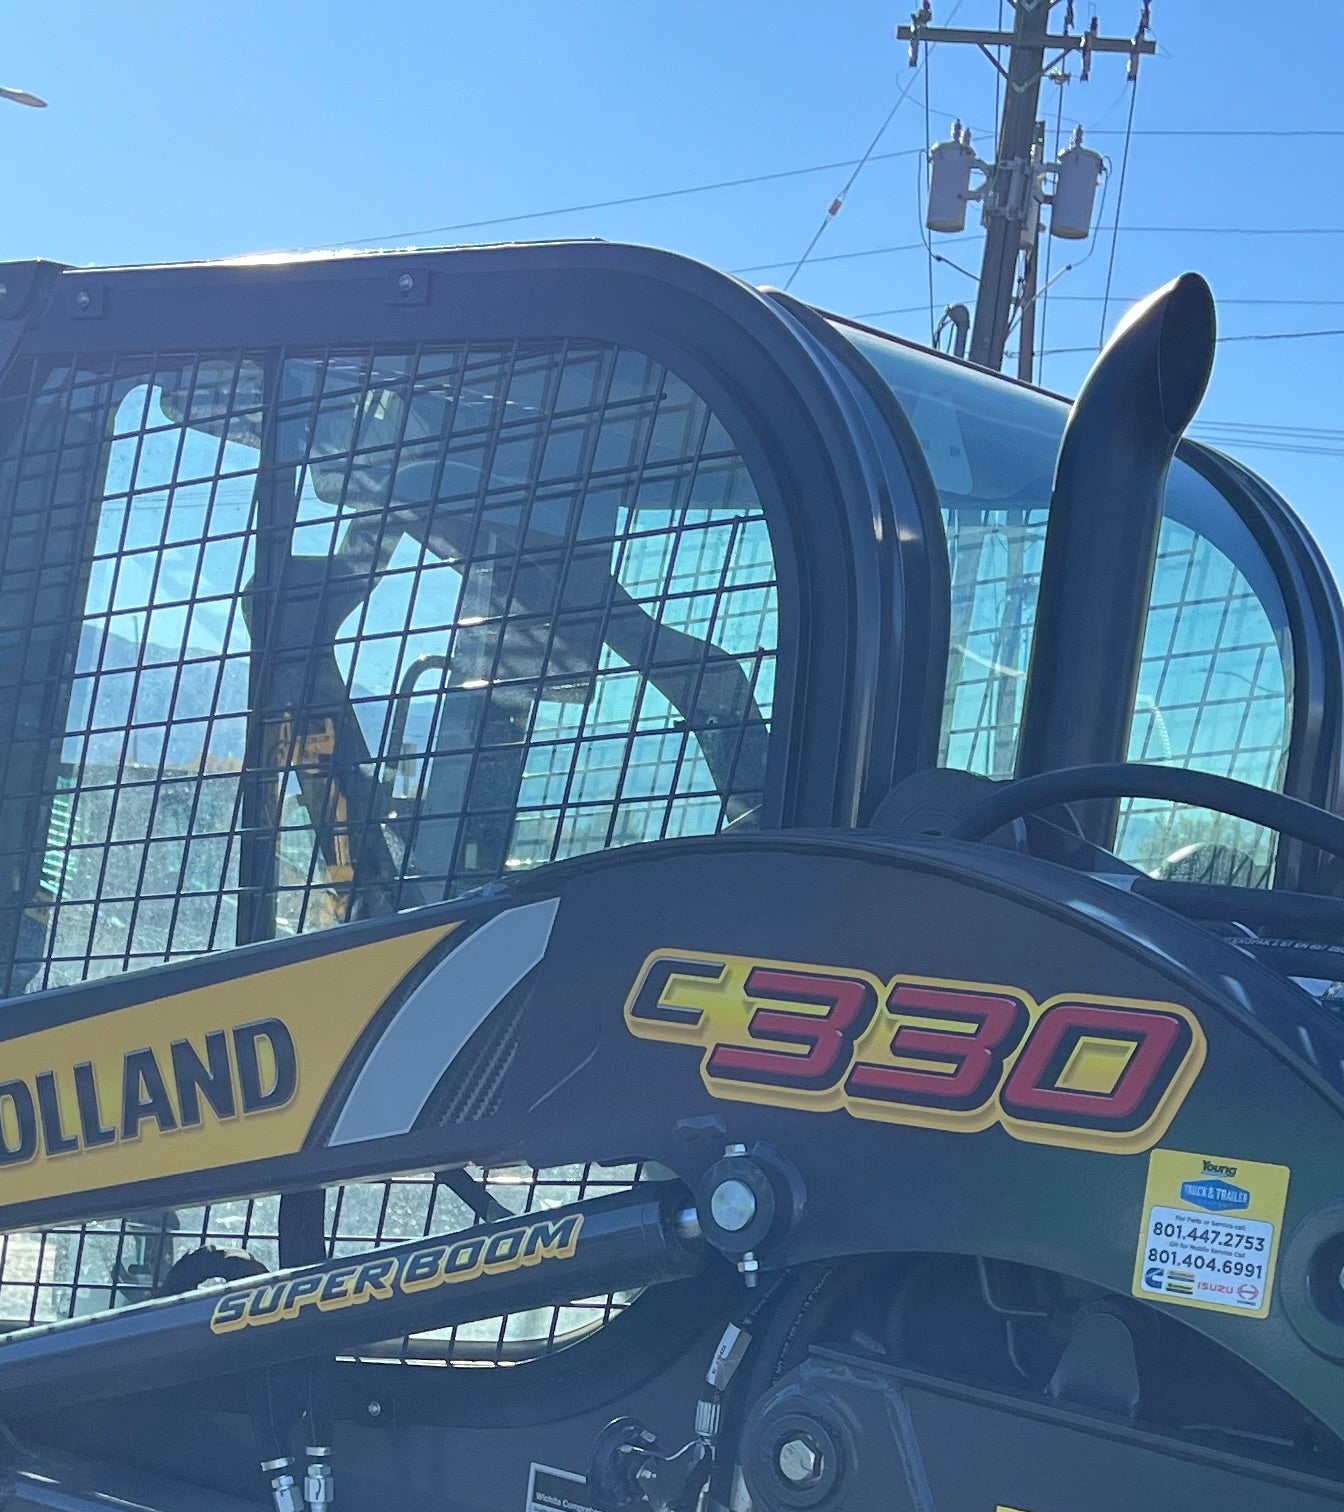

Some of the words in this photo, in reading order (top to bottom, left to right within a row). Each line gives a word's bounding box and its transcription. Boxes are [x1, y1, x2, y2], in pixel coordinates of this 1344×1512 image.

[626, 950, 1206, 1150] C330
[1201, 1159, 1237, 1178] Young
[1184, 1184, 1208, 1199] TRUCK
[1216, 1187, 1249, 1204] TRAILER
[1152, 1221, 1266, 1252] 801.447.2753
[211, 1257, 399, 1334] SUPER
[401, 1214, 585, 1293] BOOM
[1147, 1247, 1263, 1280] 801.404.6991
[1197, 1281, 1234, 1295] ISUZU
[535, 1491, 562, 1507] Wichita
